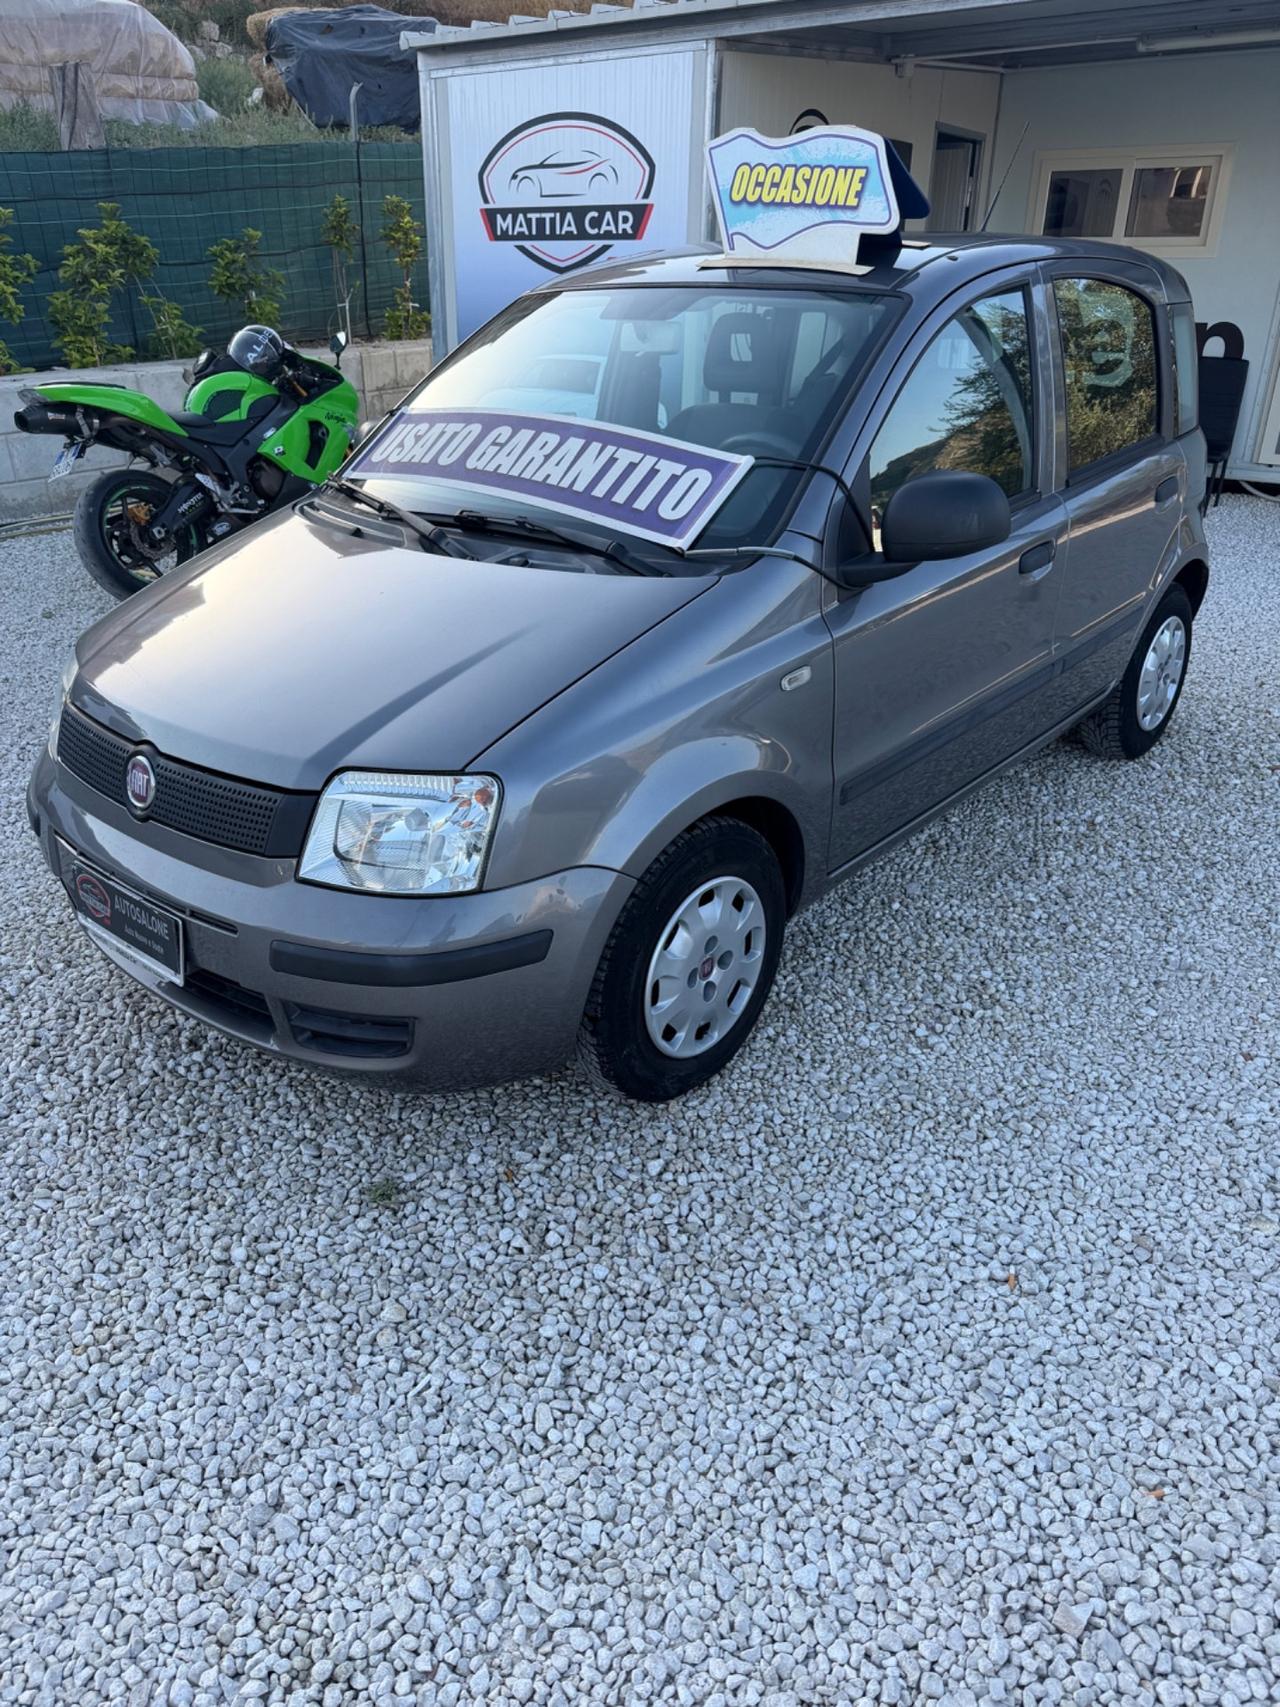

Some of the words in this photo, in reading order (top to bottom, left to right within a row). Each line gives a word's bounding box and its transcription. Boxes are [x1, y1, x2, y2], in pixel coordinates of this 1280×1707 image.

[730, 163, 868, 207] OCCASIONE
[496, 211, 578, 236] MATTIA
[584, 210, 634, 236] CAR
[369, 421, 483, 467] USATO
[464, 424, 714, 522] GARANTITO
[131, 768, 149, 798] FIAT
[114, 894, 170, 941] AUTOSALONE
